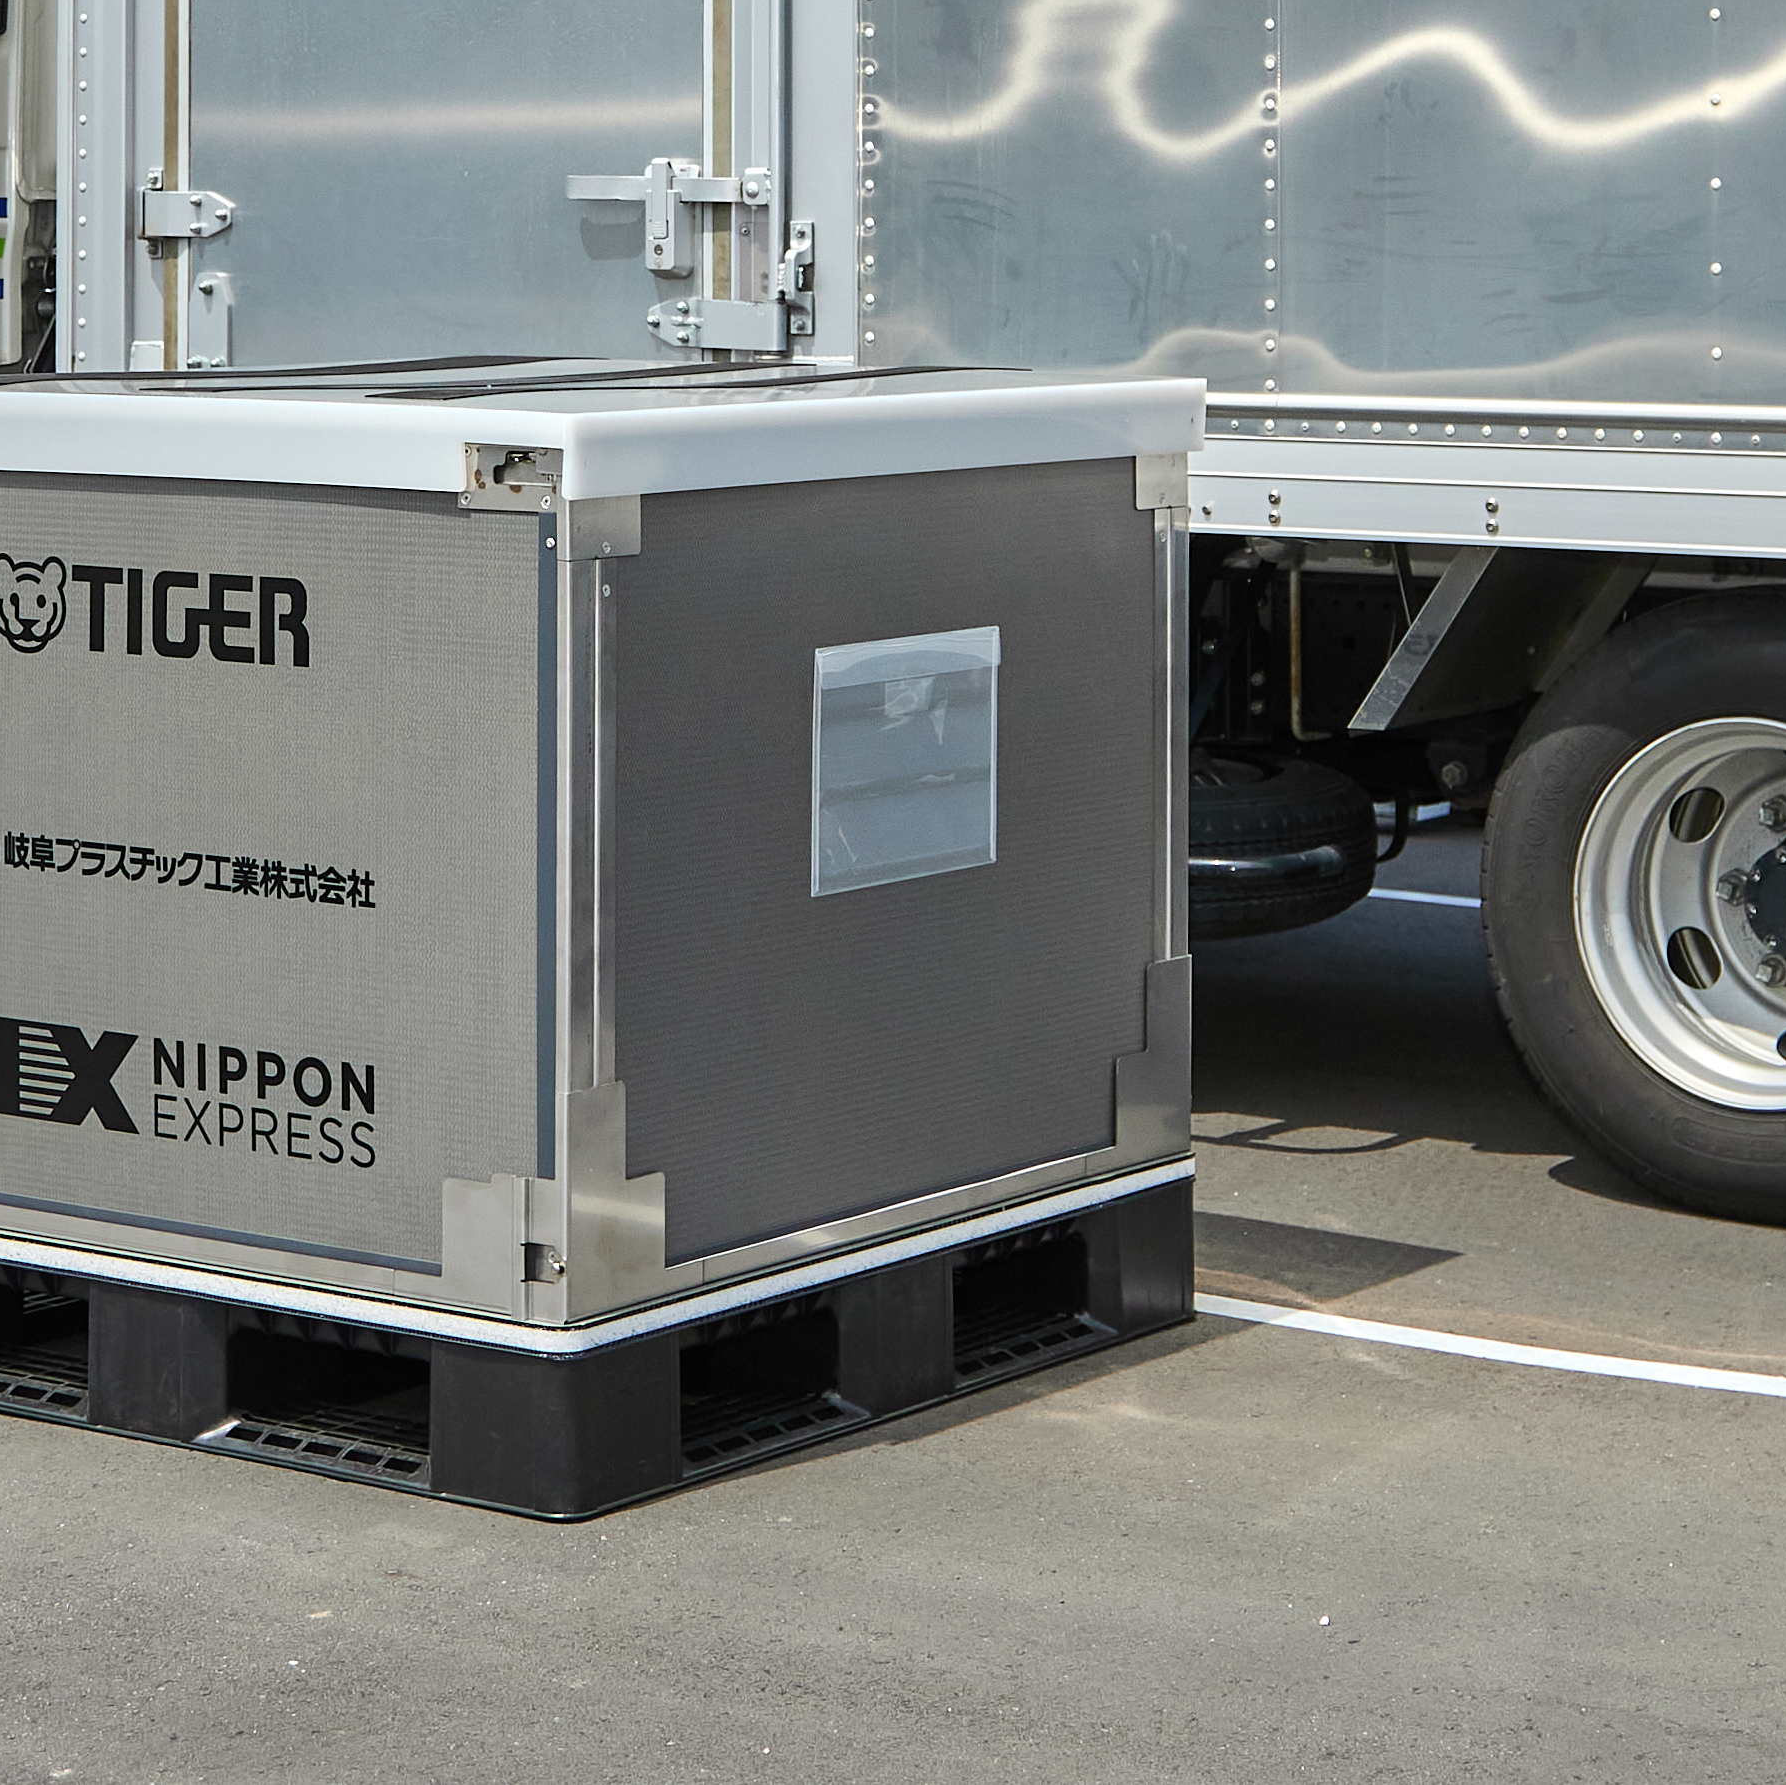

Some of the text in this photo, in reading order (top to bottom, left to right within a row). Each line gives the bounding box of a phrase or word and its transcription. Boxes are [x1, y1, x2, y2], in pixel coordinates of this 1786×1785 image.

[71, 564, 310, 668] TIGER
[4, 830, 376, 909] 岐阜プラスチック工業株式会社
[153, 1037, 375, 1115] NIPPON
[153, 1093, 376, 1169] EXPRESS
